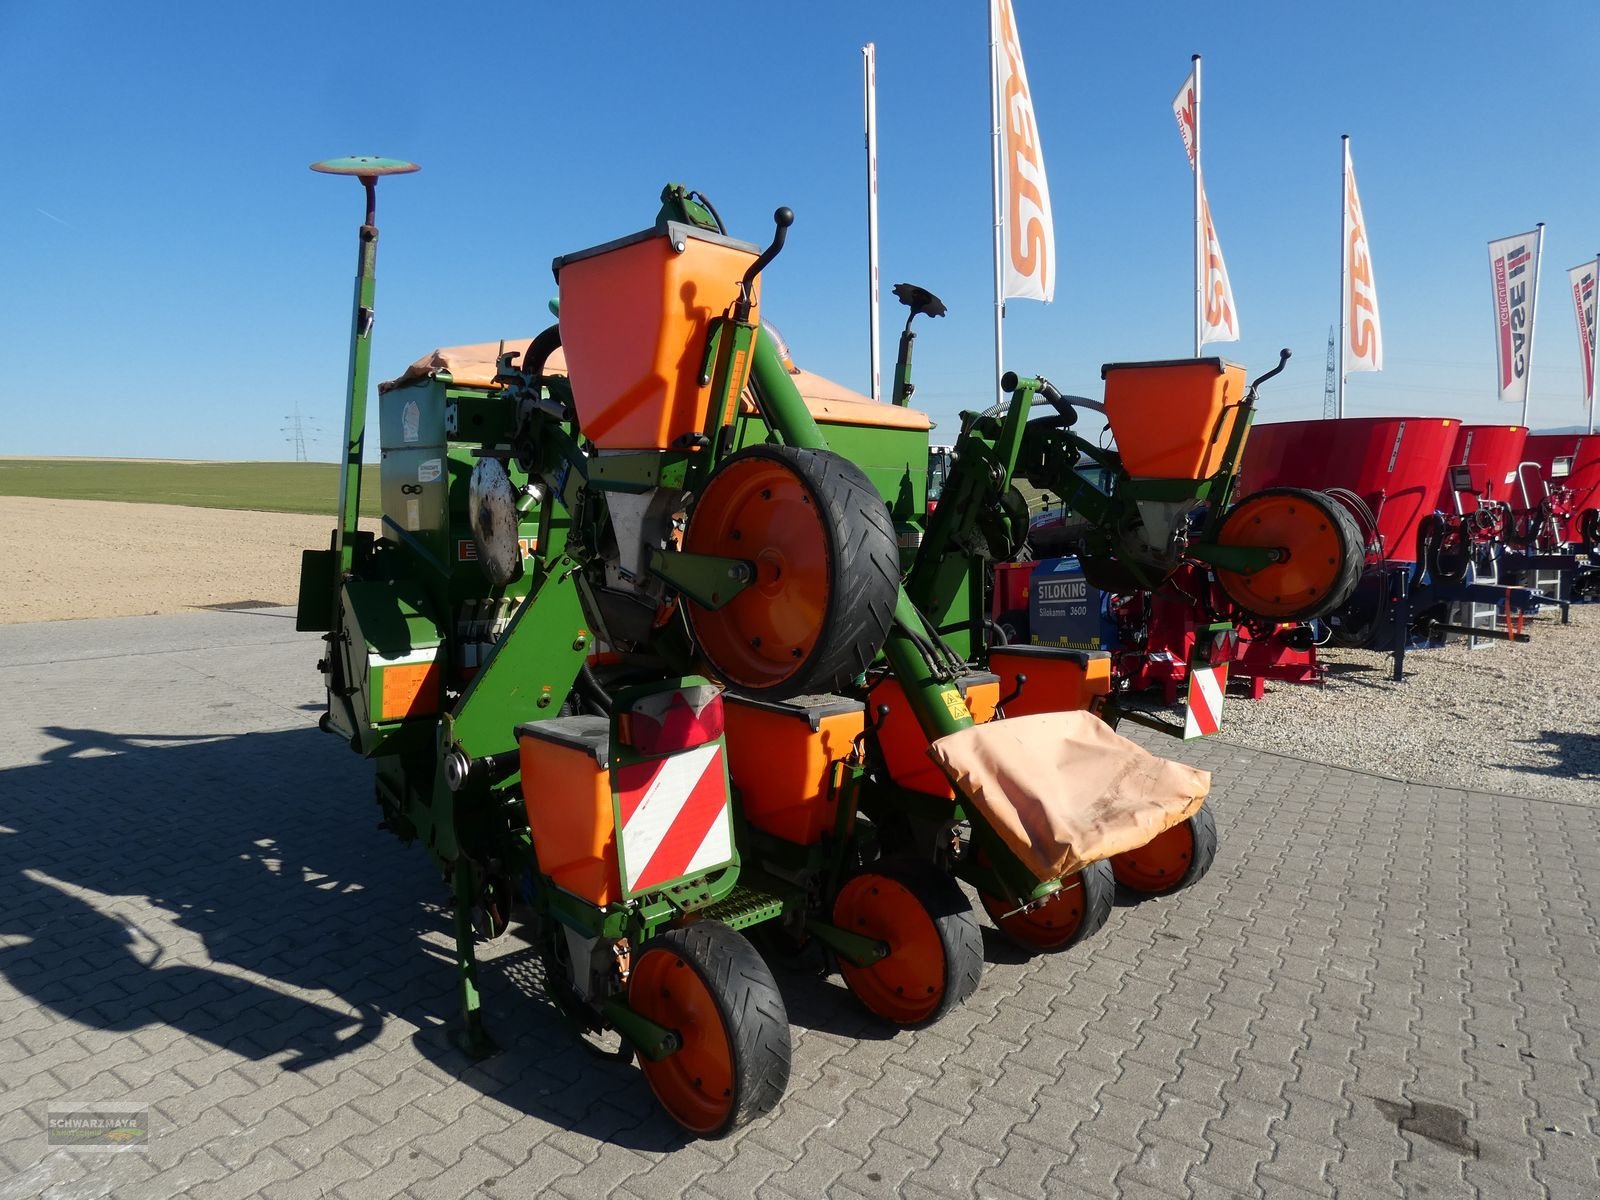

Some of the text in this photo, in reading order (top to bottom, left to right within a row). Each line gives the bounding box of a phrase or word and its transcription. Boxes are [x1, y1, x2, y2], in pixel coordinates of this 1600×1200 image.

[1038, 582, 1086, 599] SILOKING
[1039, 606, 1087, 617] Silokamm 3600
